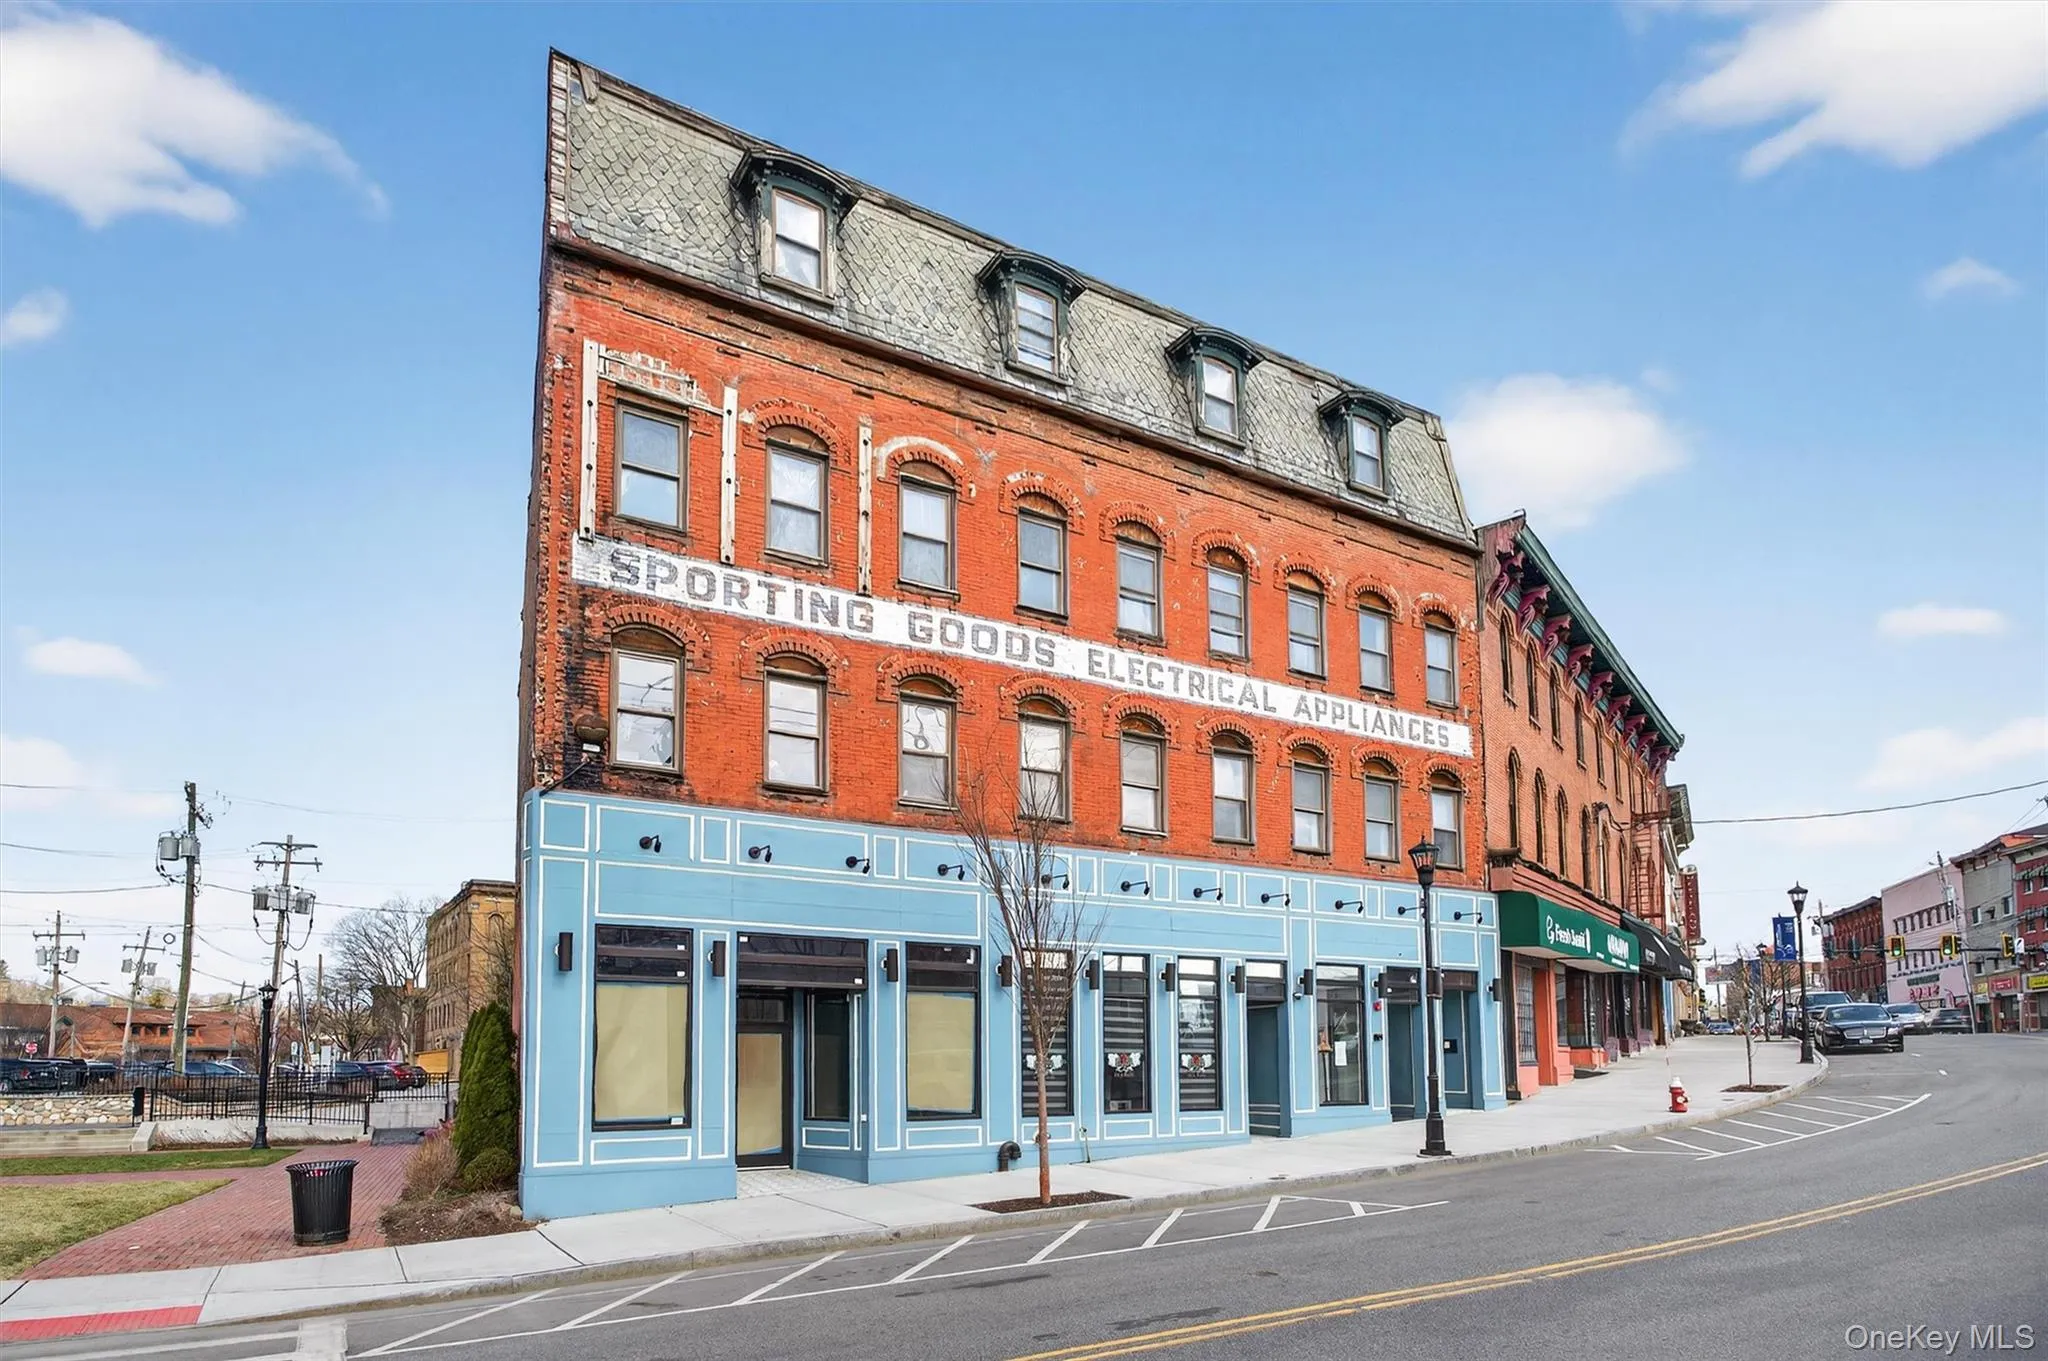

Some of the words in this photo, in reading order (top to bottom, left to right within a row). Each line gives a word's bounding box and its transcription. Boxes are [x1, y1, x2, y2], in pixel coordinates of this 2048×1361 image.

[610, 548, 874, 633] SPORTING
[908, 610, 1055, 668] GOODS
[1088, 647, 1277, 714] ELECTRICAL
[1293, 694, 1450, 748] APPLIANCES
